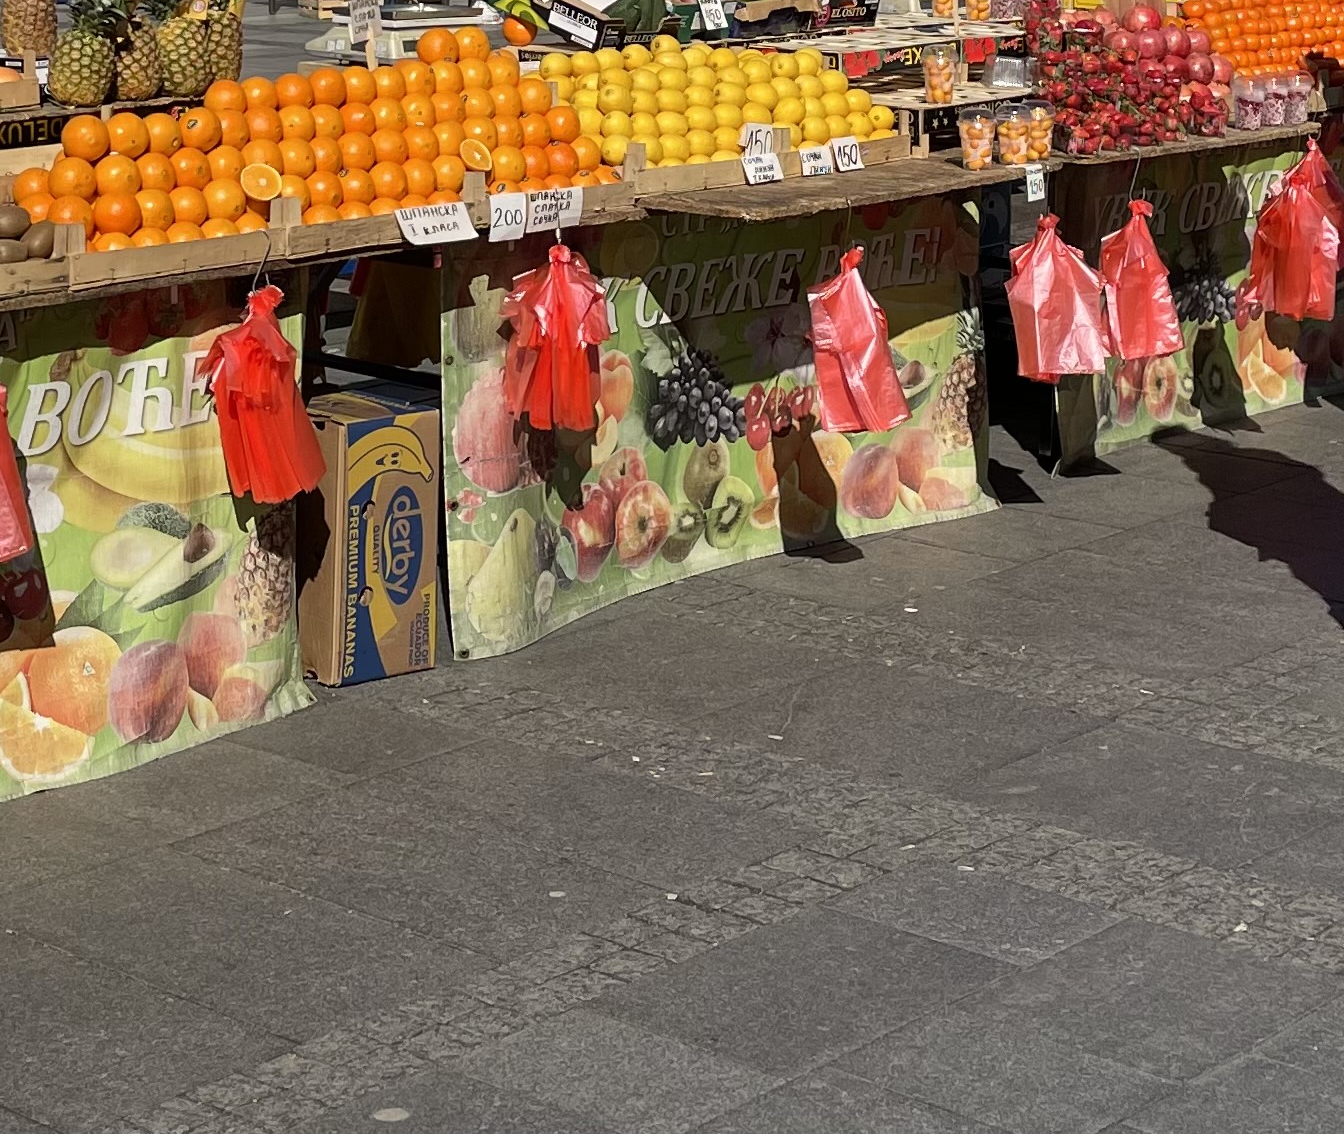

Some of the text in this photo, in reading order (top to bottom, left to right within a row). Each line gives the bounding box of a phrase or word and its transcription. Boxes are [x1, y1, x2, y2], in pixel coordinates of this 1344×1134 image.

[746, 129, 773, 156] 150
[837, 143, 858, 168] 150
[400, 203, 459, 221] ШПАНСКА
[492, 207, 524, 229] 200
[635, 248, 805, 329] СВЕЖЕ
[372, 524, 381, 576] QUALITY
[384, 494, 422, 596] derby
[343, 504, 362, 679] PREMIUM BANANAS
[413, 612, 423, 666] ECUADOR
[420, 593, 431, 665] PRODUCE OF
